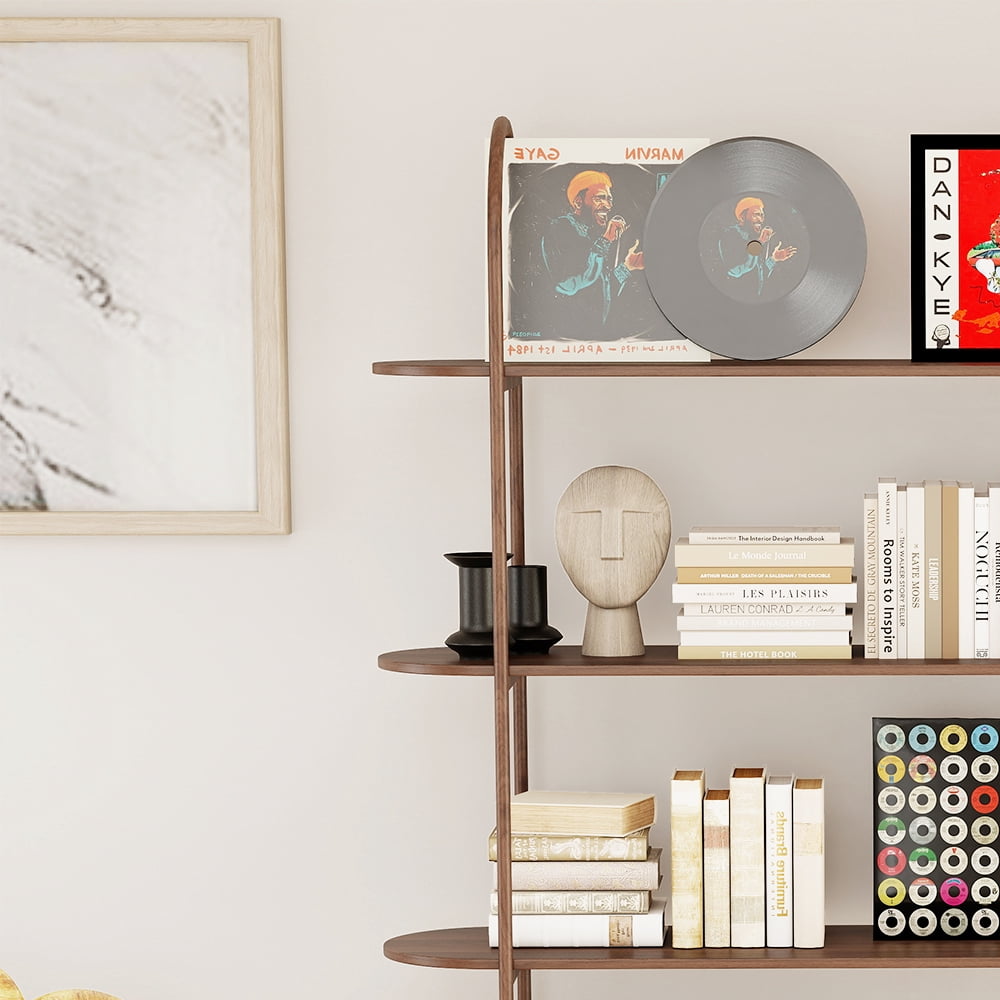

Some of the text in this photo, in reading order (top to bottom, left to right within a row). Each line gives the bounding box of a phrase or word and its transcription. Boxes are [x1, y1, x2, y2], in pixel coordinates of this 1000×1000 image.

[932, 156, 952, 220] DAN
[932, 251, 952, 316] KYE
[742, 589, 764, 598] LES
[868, 590, 876, 603] DE
[881, 539, 895, 653] Rooms to Inspire
[912, 552, 920, 608] KATE MOSS
[928, 558, 939, 600] LEADERSHIP
[976, 530, 989, 621] NOGUCHI
[700, 605, 744, 614] LAUREN
[748, 605, 793, 614] CONRAD
[868, 645, 876, 654] EL
